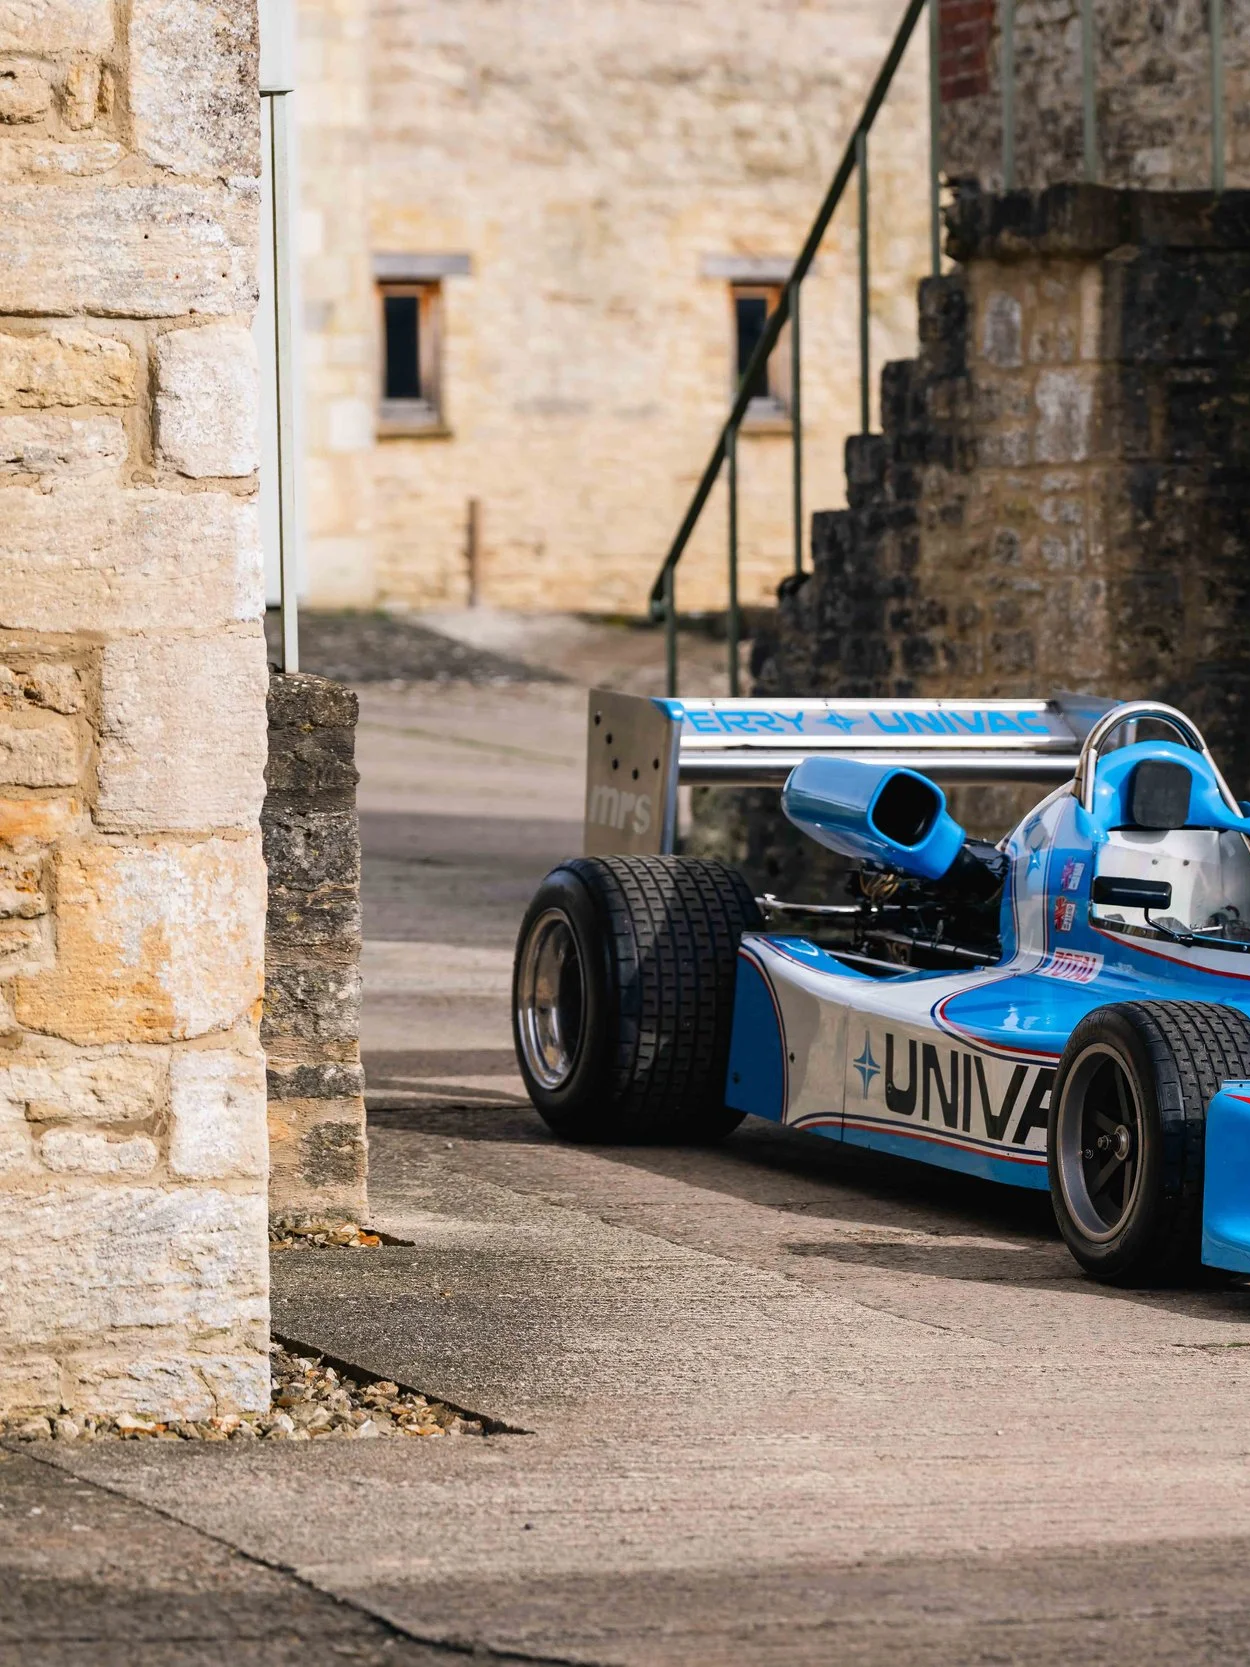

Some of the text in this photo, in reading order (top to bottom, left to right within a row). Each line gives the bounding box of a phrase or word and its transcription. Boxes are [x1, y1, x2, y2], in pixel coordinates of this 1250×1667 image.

[684, 711, 1050, 734] ERRY UNIVAC
[588, 785, 652, 835] mrs
